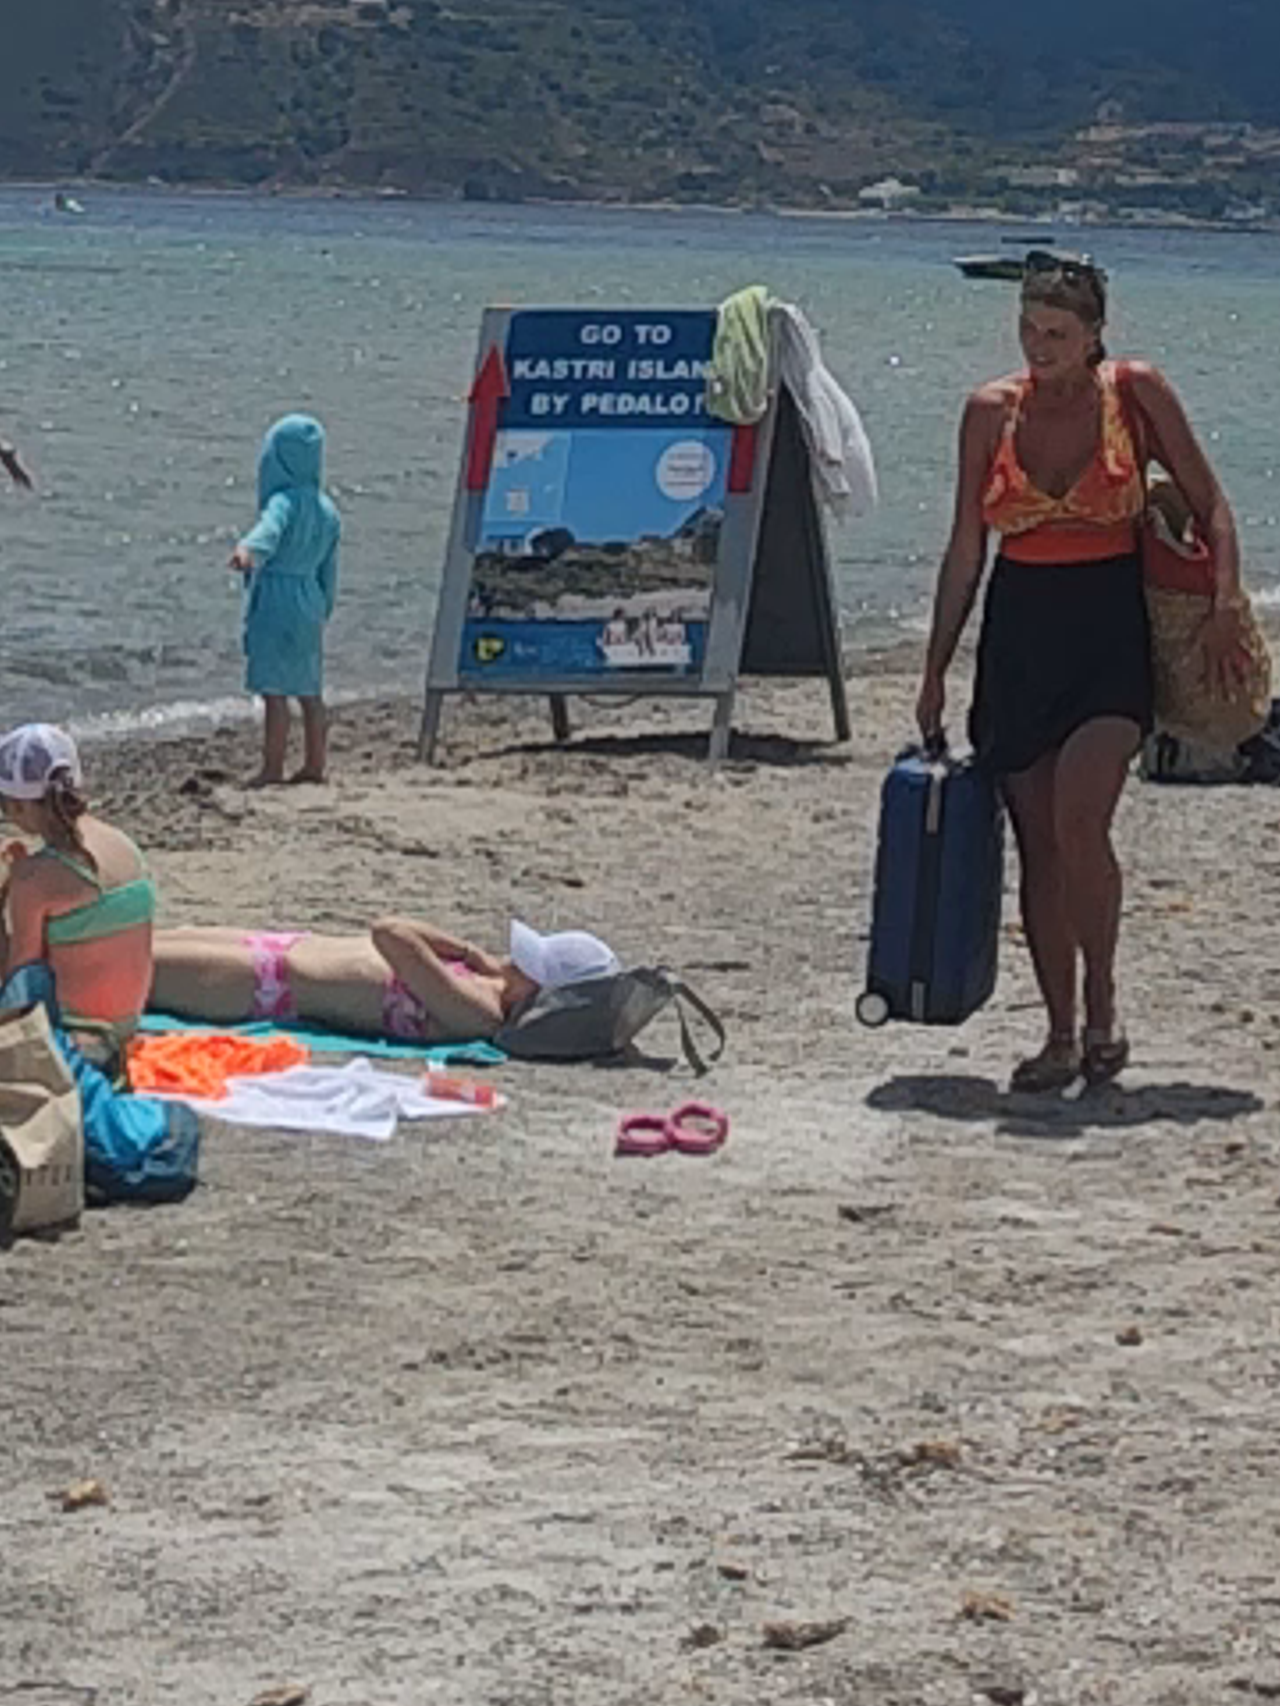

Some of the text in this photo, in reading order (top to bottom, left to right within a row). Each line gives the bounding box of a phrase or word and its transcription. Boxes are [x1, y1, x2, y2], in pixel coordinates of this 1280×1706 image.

[580, 324, 672, 344] GO TO
[513, 359, 711, 379] KASTRI ISLAN
[531, 393, 569, 415] BY
